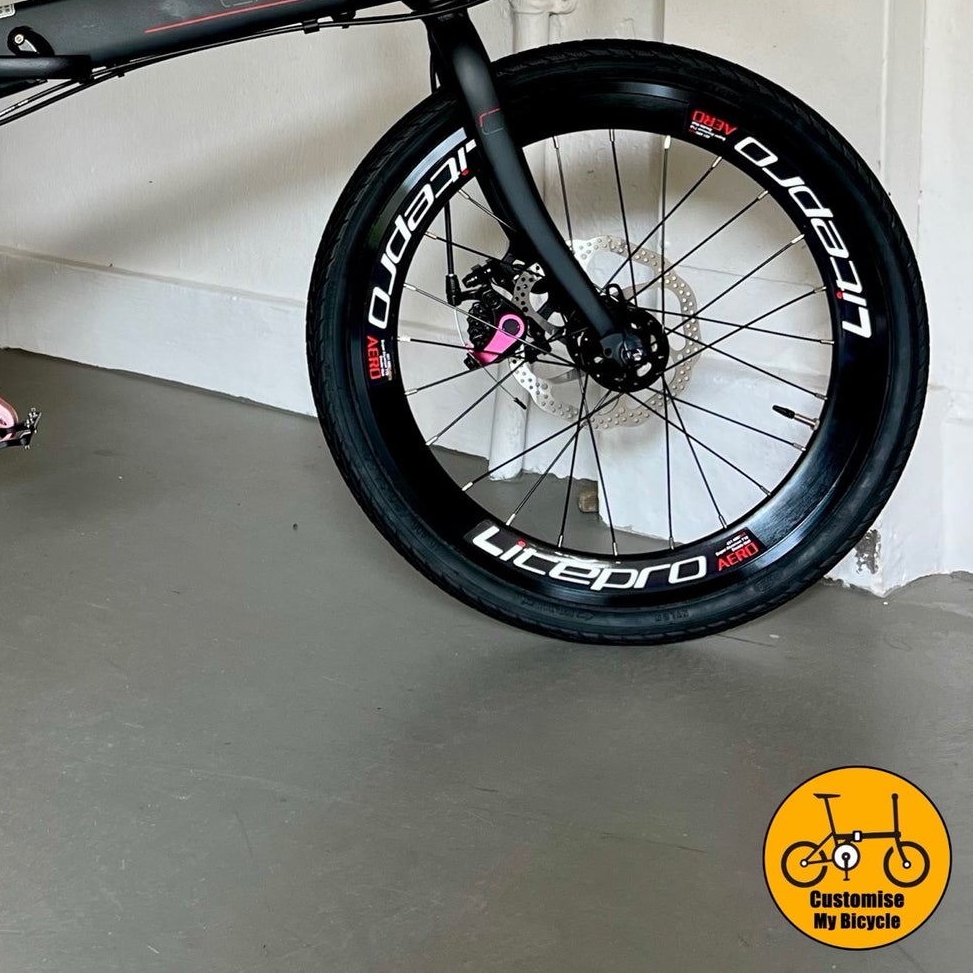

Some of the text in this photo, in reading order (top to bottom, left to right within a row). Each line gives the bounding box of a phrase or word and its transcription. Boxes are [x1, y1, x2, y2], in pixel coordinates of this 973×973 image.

[692, 109, 738, 135] AERO
[368, 139, 477, 329] itepro
[366, 335, 382, 380] AERO
[716, 541, 759, 572] AERO
